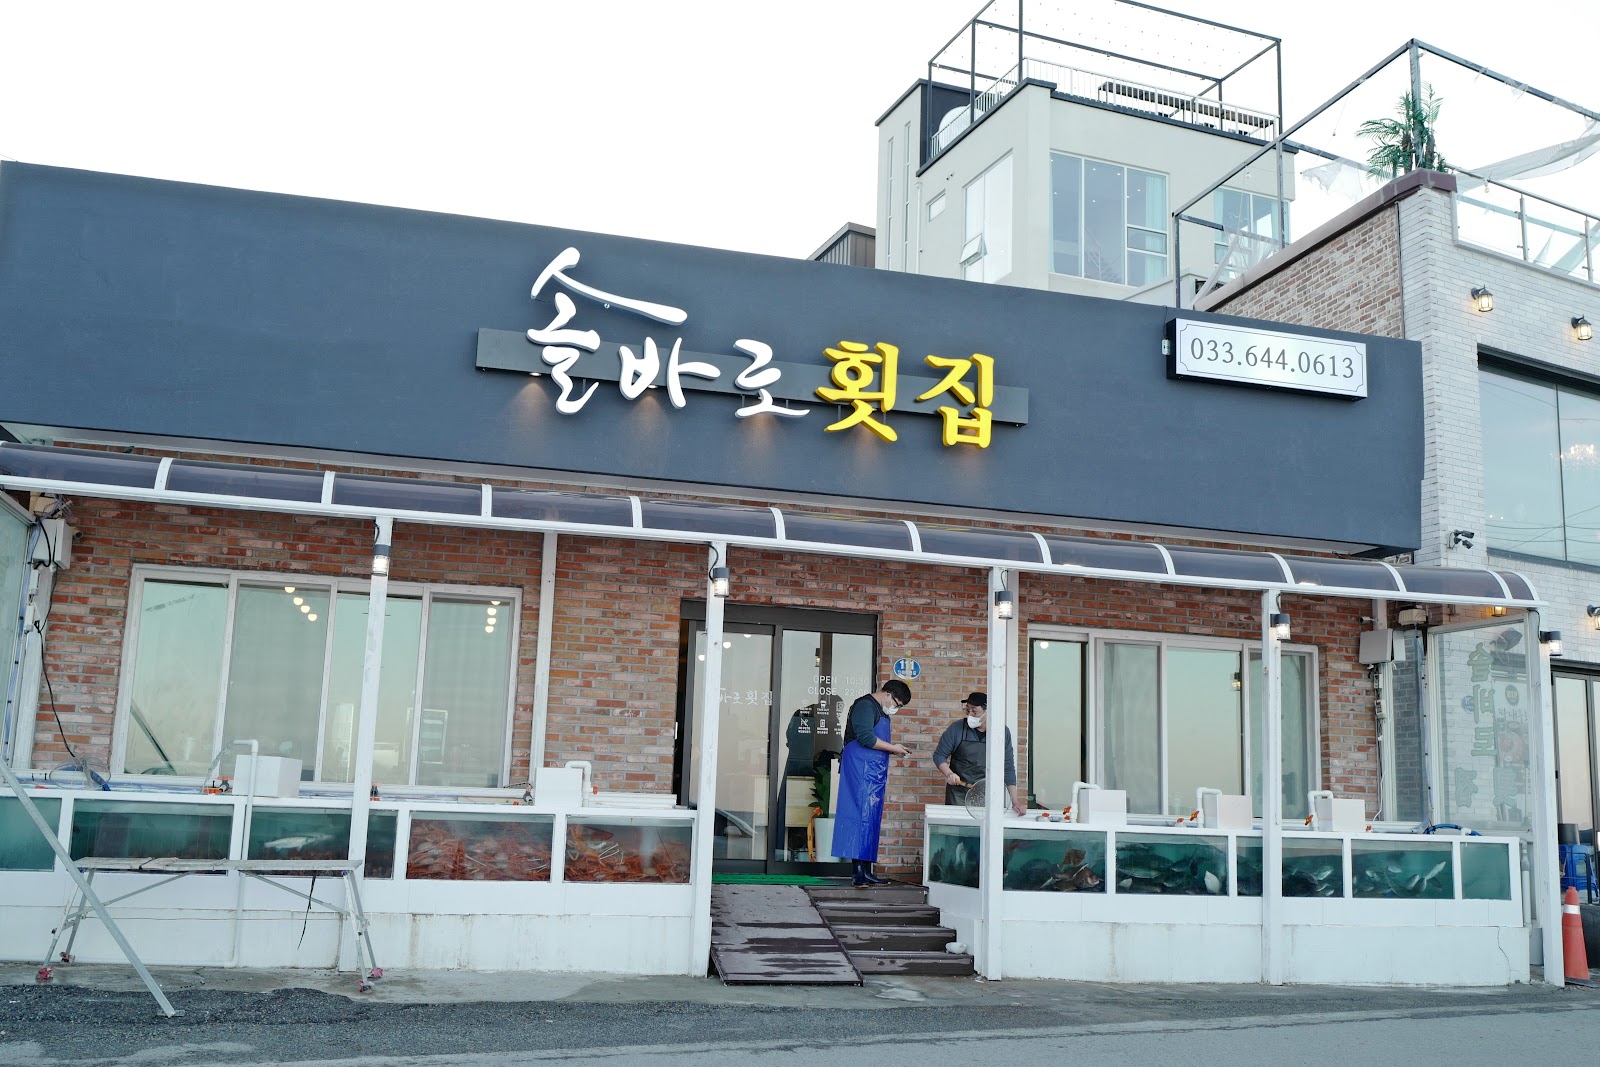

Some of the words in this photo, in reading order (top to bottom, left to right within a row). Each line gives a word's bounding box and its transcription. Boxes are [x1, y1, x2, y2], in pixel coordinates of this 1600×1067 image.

[526, 246, 810, 418] 솔바로
[816, 341, 995, 449] 횟집
[1190, 337, 1355, 379] 033.644.0613
[813, 675, 837, 684] OPEN
[845, 676, 869, 686] 10:30
[719, 690, 744, 705] 바로
[808, 686, 837, 696] CLOSE
